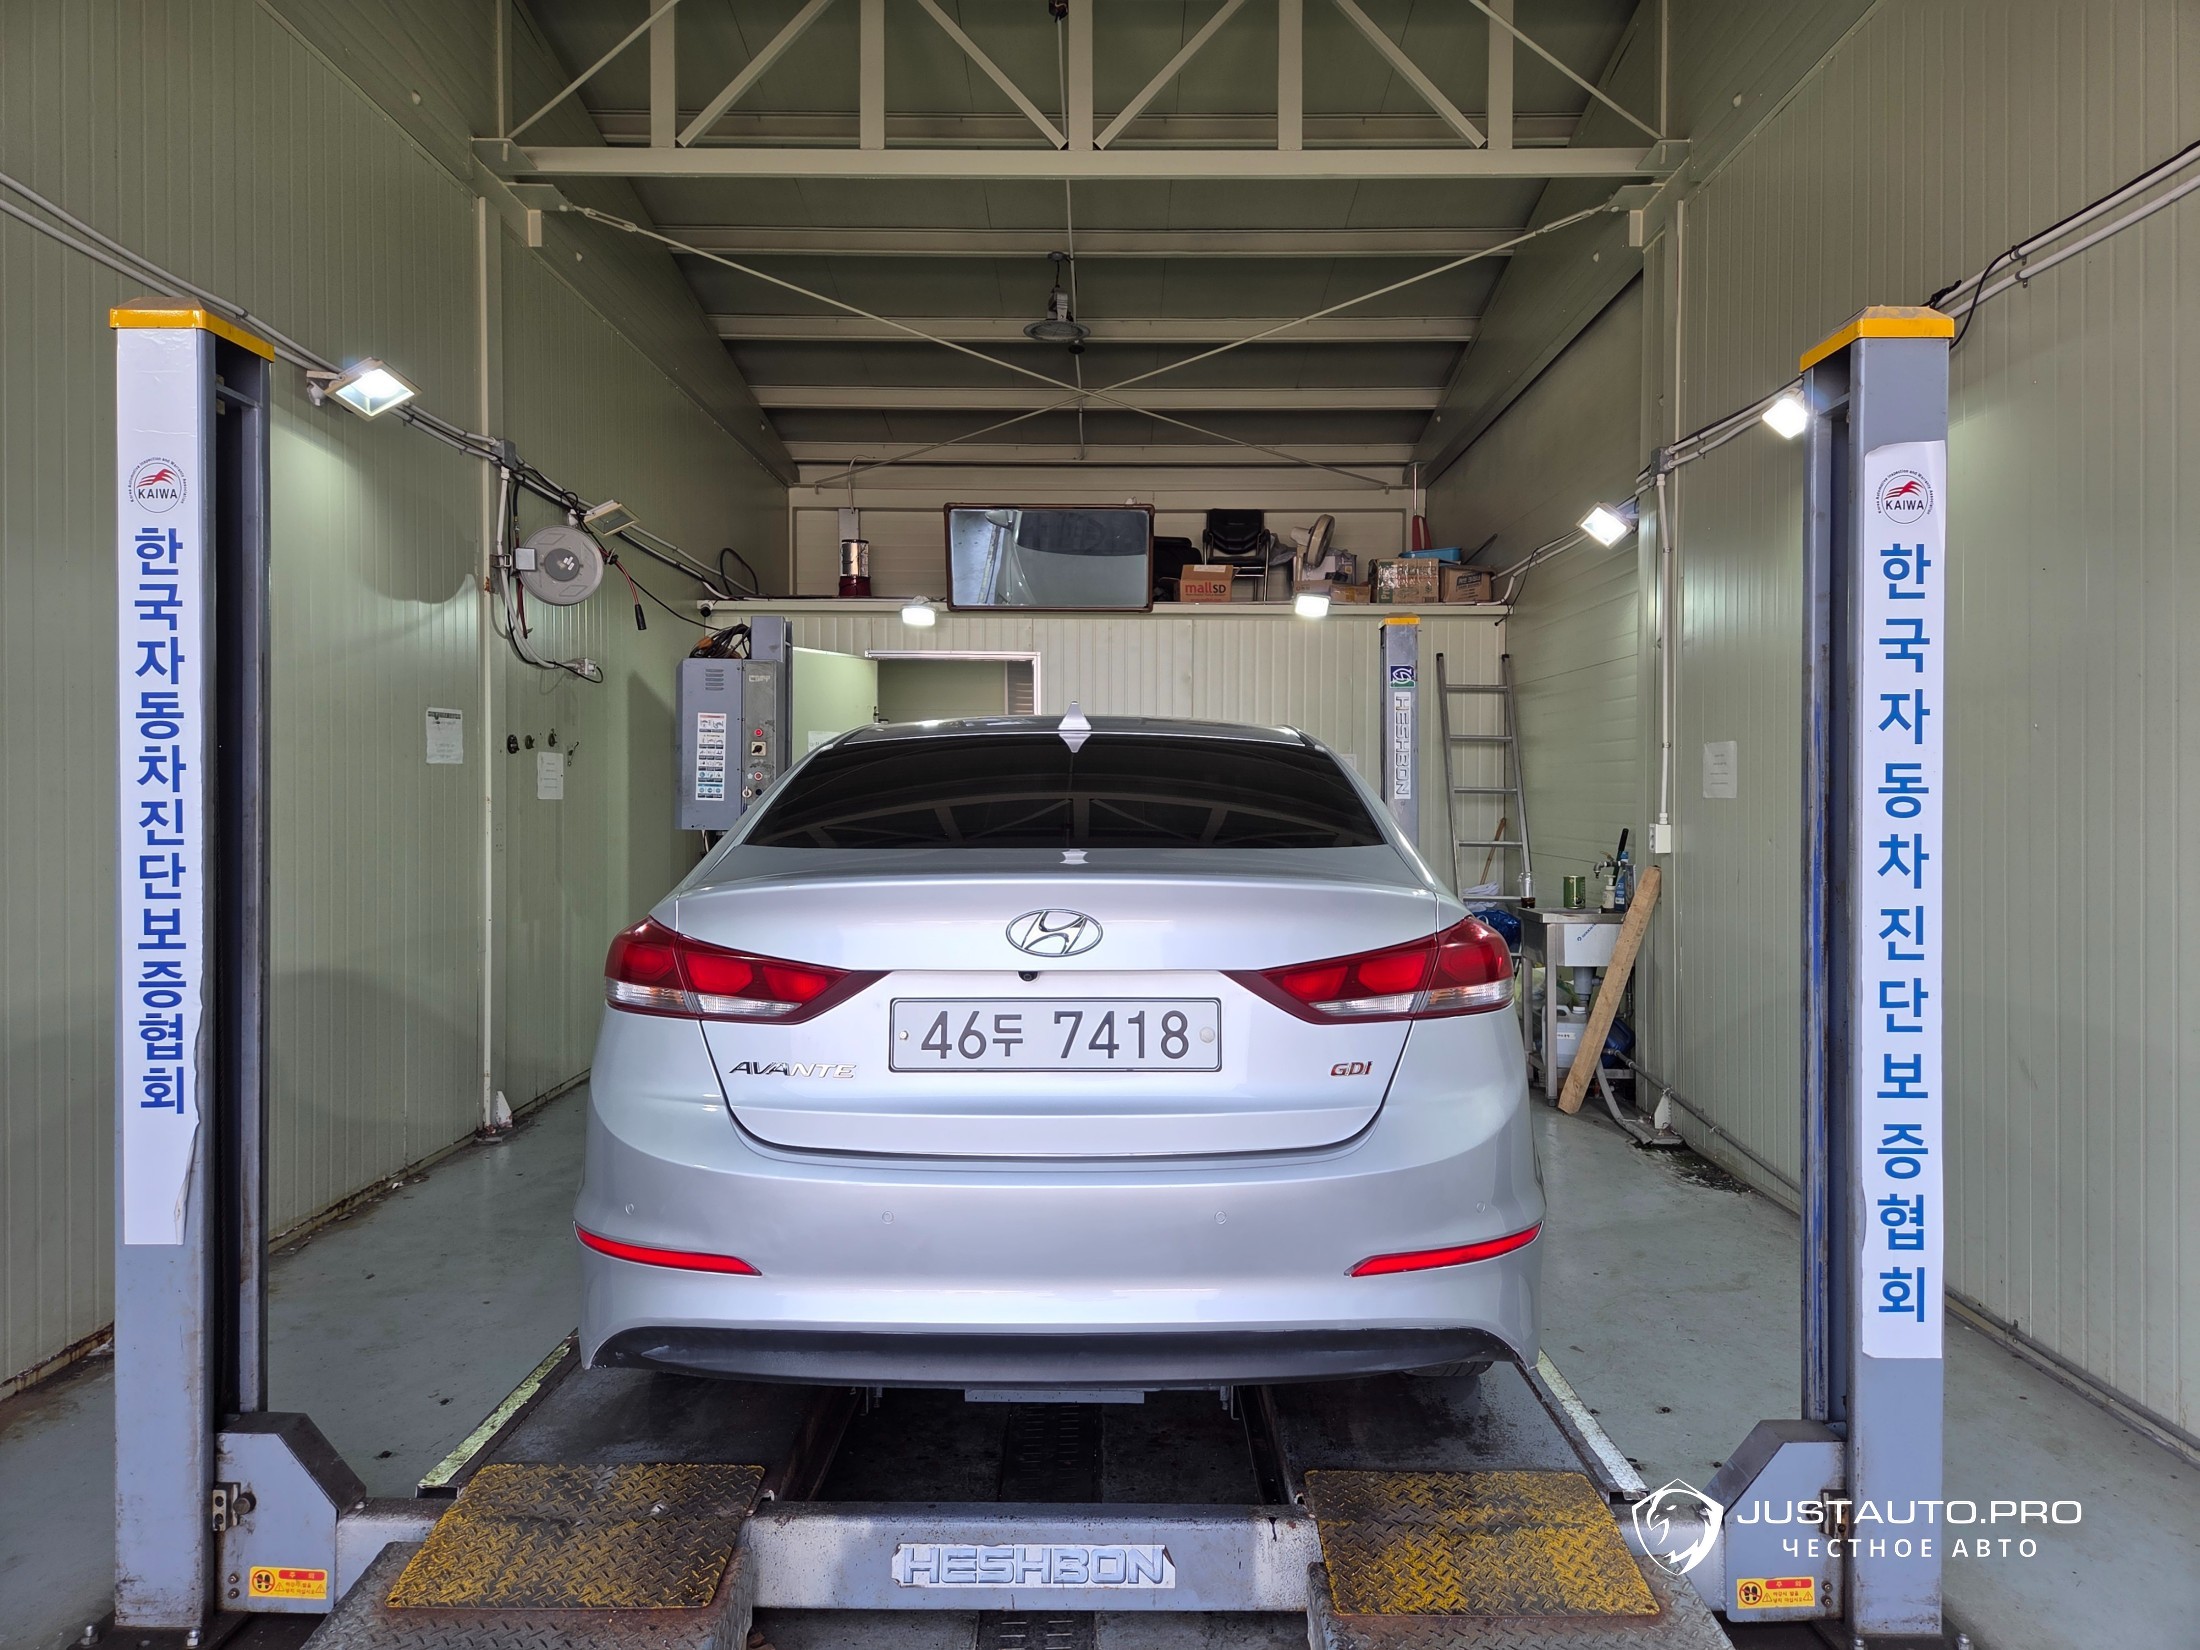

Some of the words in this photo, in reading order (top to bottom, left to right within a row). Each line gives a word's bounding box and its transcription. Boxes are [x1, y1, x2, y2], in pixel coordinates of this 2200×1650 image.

[138, 489, 178, 499] KAIWA
[1885, 500, 1924, 510] KAIWA
[1395, 696, 1410, 795] HESHBON
[134, 527, 187, 1115] 한국자동차진단보증협회
[1876, 543, 1931, 1323] 한국자동차진단보증협회
[921, 1010, 1024, 1060] 46두
[1053, 1010, 1189, 1060] 7418
[729, 1061, 857, 1078] AVANTE
[1330, 1062, 1372, 1077] GDI
[903, 1548, 1164, 1584] HESHBON
